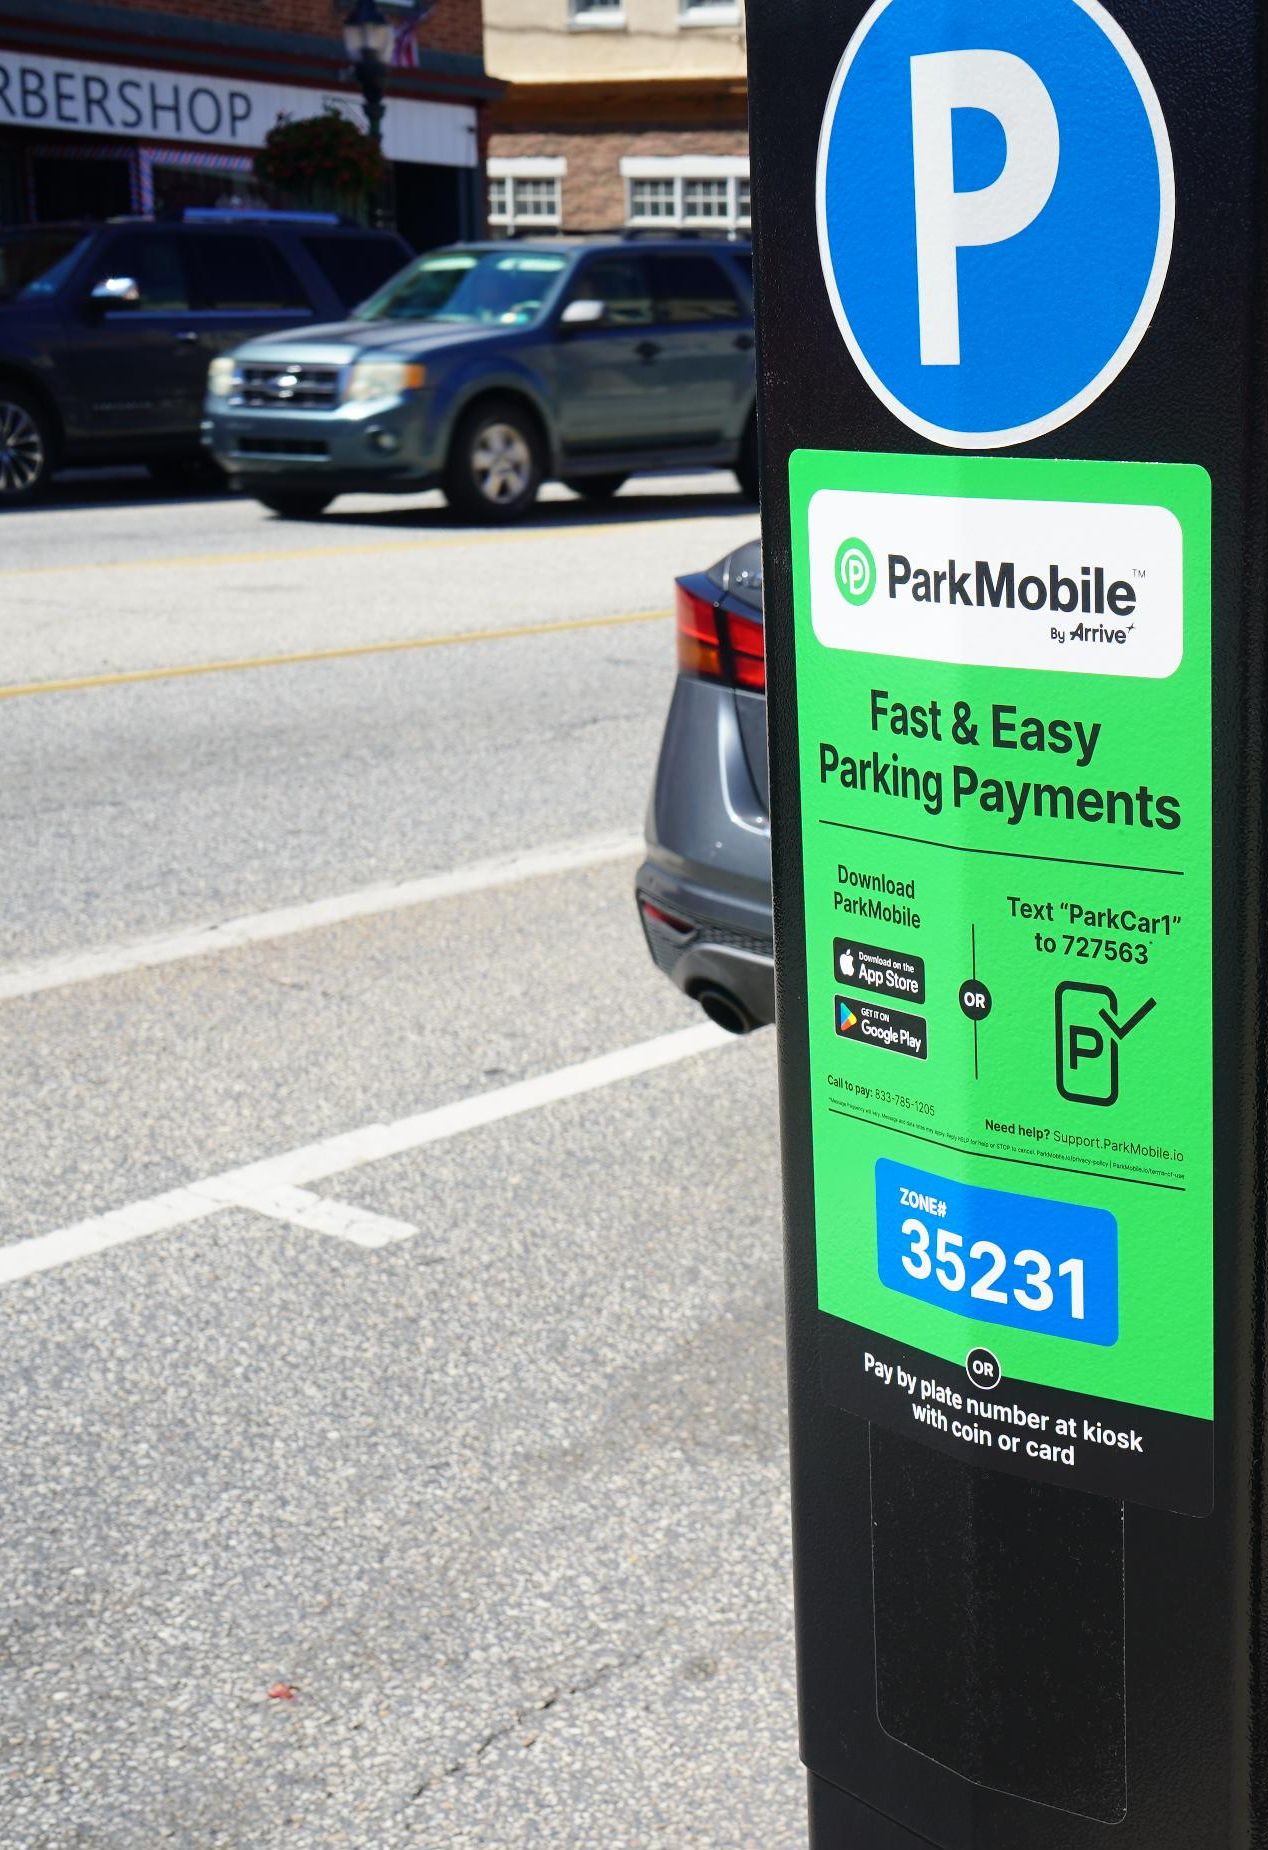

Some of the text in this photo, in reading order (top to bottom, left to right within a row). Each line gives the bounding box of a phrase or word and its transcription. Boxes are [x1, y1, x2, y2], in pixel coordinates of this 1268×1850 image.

[910, 48, 1060, 366] P
[887, 554, 1137, 617] ParkMobile
[1050, 622, 1127, 645] By Arrive
[870, 689, 1102, 767] Fast & Easy
[819, 743, 1182, 830] Parking Payments
[838, 864, 916, 900] Download
[833, 891, 921, 929] ParkMobile
[1006, 896, 1055, 922] Text
[1034, 932, 1057, 955] to
[858, 951, 915, 973] Download on the
[859, 963, 919, 994] App Store
[861, 1007, 873, 1017] GET
[880, 1012, 890, 1022] ON
[964, 991, 986, 1010] OR
[861, 1019, 922, 1052] Google Play
[827, 1074, 936, 1117] Call to pay: 833-785-1205
[985, 1118, 1184, 1162] Need help? Support.ParkMobile.io
[898, 1187, 948, 1218] ZONE#
[900, 1217, 1085, 1320] 35231
[972, 1359, 994, 1378] OR
[864, 1351, 1144, 1453] Pay by plate number at kiosk
[912, 1402, 1075, 1466] with coin or card
